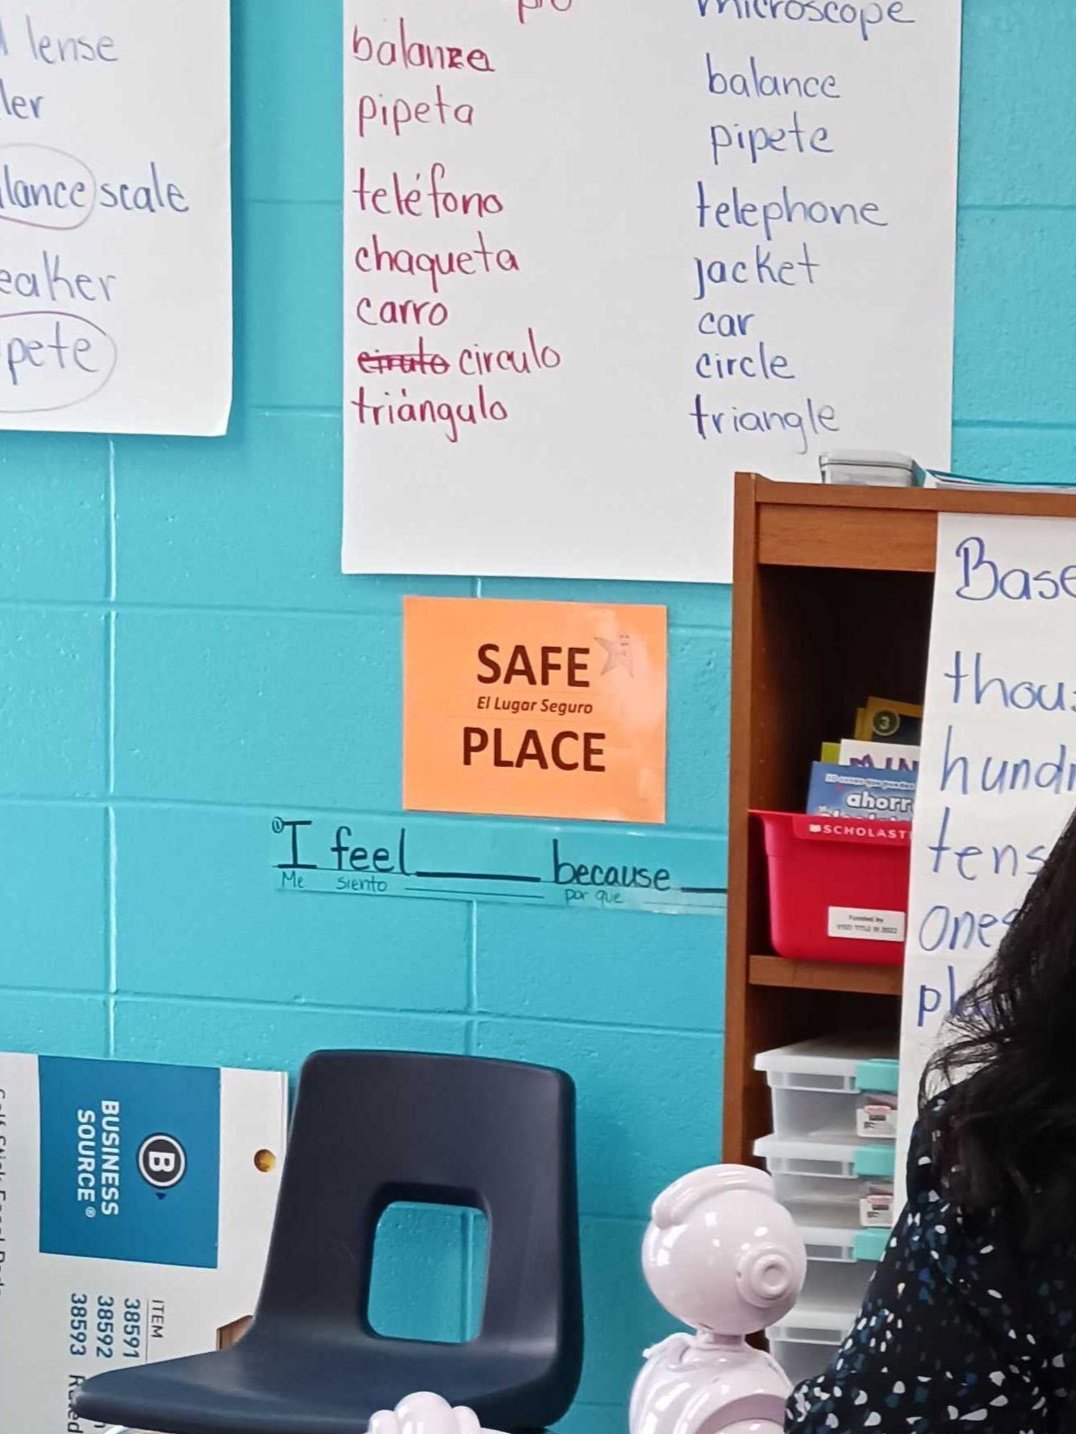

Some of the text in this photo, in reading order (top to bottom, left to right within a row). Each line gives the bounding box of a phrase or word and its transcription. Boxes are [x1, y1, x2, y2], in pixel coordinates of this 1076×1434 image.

[27, 14, 118, 64] lense
[697, 0, 916, 41] microscope
[0, 78, 44, 119] ler
[706, 52, 841, 98] balance
[359, 84, 474, 137] pipeta
[711, 111, 835, 165] pipete
[0, 162, 189, 213] lance scale
[352, 163, 504, 218] teléfono
[697, 181, 888, 241] telephone
[355, 231, 520, 293] chaqueta
[693, 242, 821, 300] jacket
[356, 297, 448, 326] carro
[698, 312, 755, 337] car
[0, 321, 100, 385] pete
[695, 341, 796, 379] circle
[351, 384, 508, 443] triángulo
[689, 393, 840, 455] triangle
[477, 643, 590, 687] SAFE
[477, 696, 593, 716] El Lugar Seguro
[463, 727, 606, 772] PLACE
[846, 790, 916, 813] ahorr
[277, 820, 318, 869] I
[331, 826, 411, 876] feel
[553, 838, 671, 891] because
[823, 824, 912, 840] SCHOLAST
[336, 875, 388, 892] siento
[77, 1109, 96, 1202] SOURCE
[101, 1100, 120, 1216] BUSINESS
[96, 1296, 115, 1359] 38592
[122, 1298, 141, 1359] 38591
[150, 1299, 165, 1339] ITEM
[67, 1293, 88, 1433] 38593 Red
